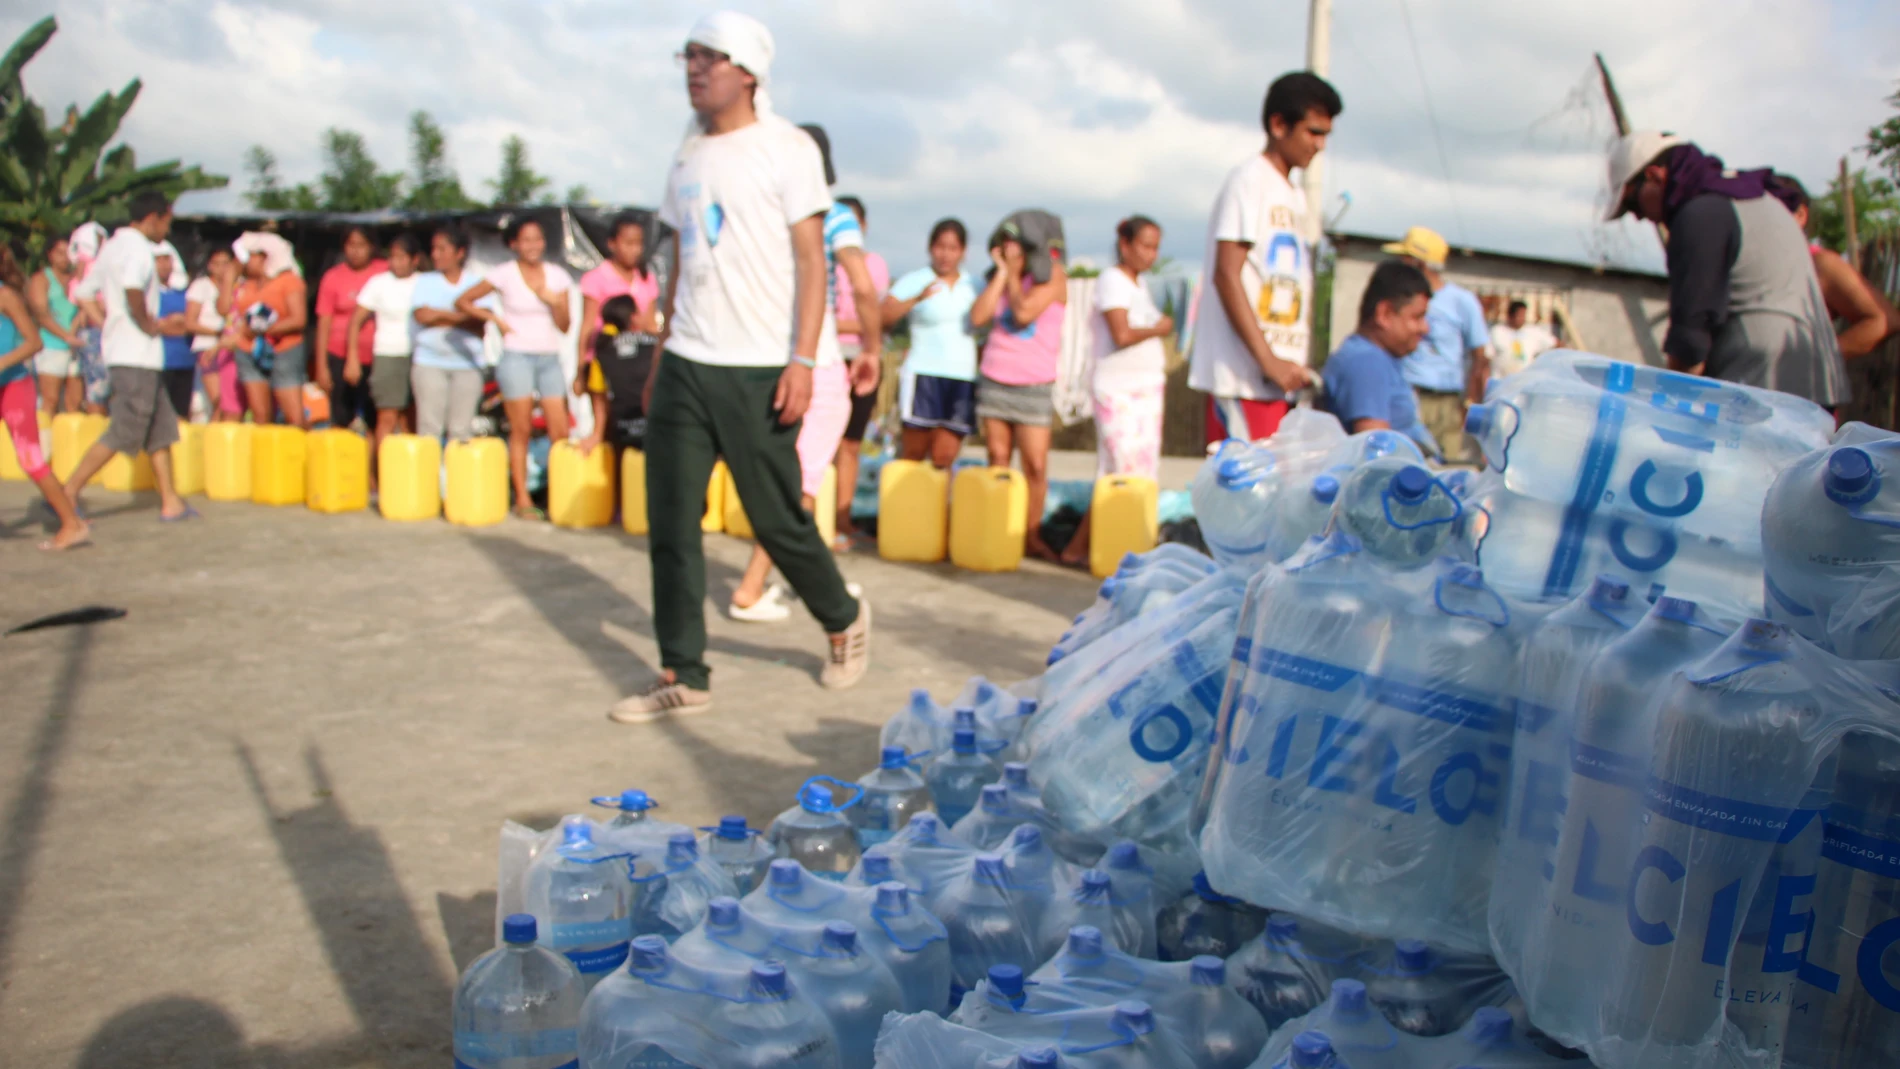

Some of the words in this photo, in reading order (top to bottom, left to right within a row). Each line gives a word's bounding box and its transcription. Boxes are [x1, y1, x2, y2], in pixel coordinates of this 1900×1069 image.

[1674, 800, 1737, 822] ENVASADA
[1740, 815, 1762, 827] SIN
[1766, 820, 1789, 830] GAS
[1823, 837, 1885, 862] URIFICADA
[1713, 979, 1782, 1004] ELEVA
